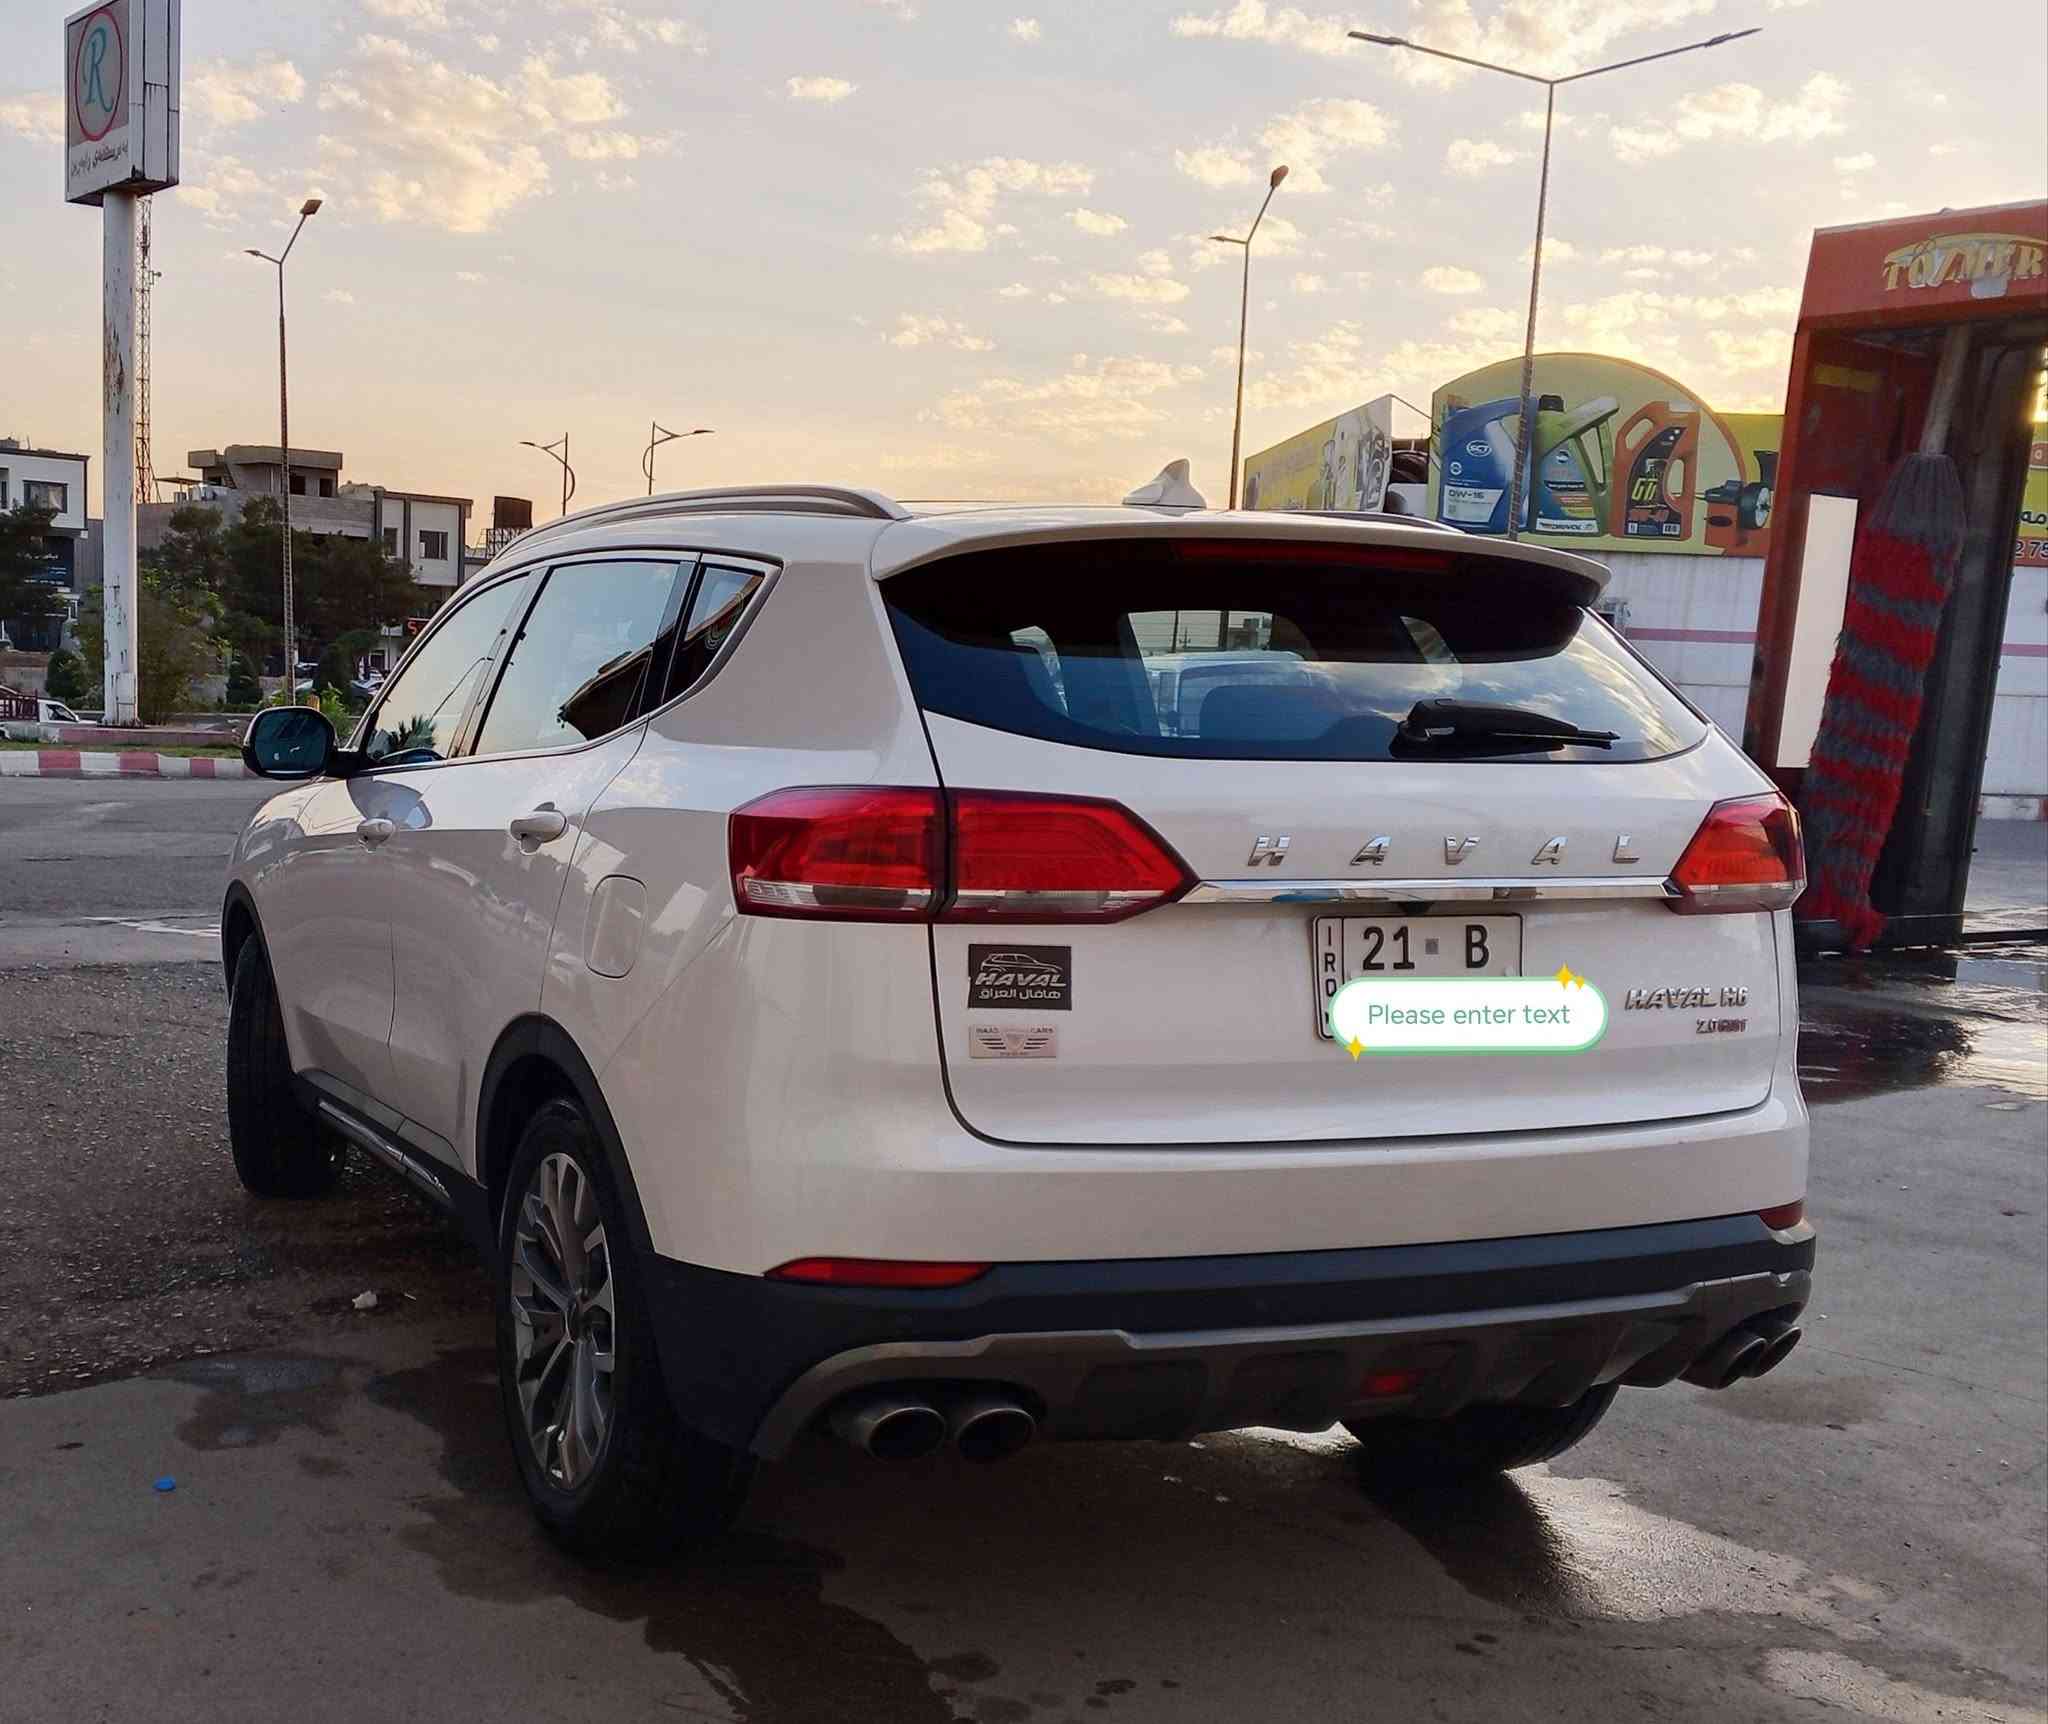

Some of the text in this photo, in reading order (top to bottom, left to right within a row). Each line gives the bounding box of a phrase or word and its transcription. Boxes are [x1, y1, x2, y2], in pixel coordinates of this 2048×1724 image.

[1247, 835, 1641, 867] HAVAL
[1362, 924, 1490, 971] 21 B
[975, 972, 1067, 987] HAVAL
[978, 988, 1061, 1000] هافال العراق
[1625, 987, 1748, 1010] HAVAL H6
